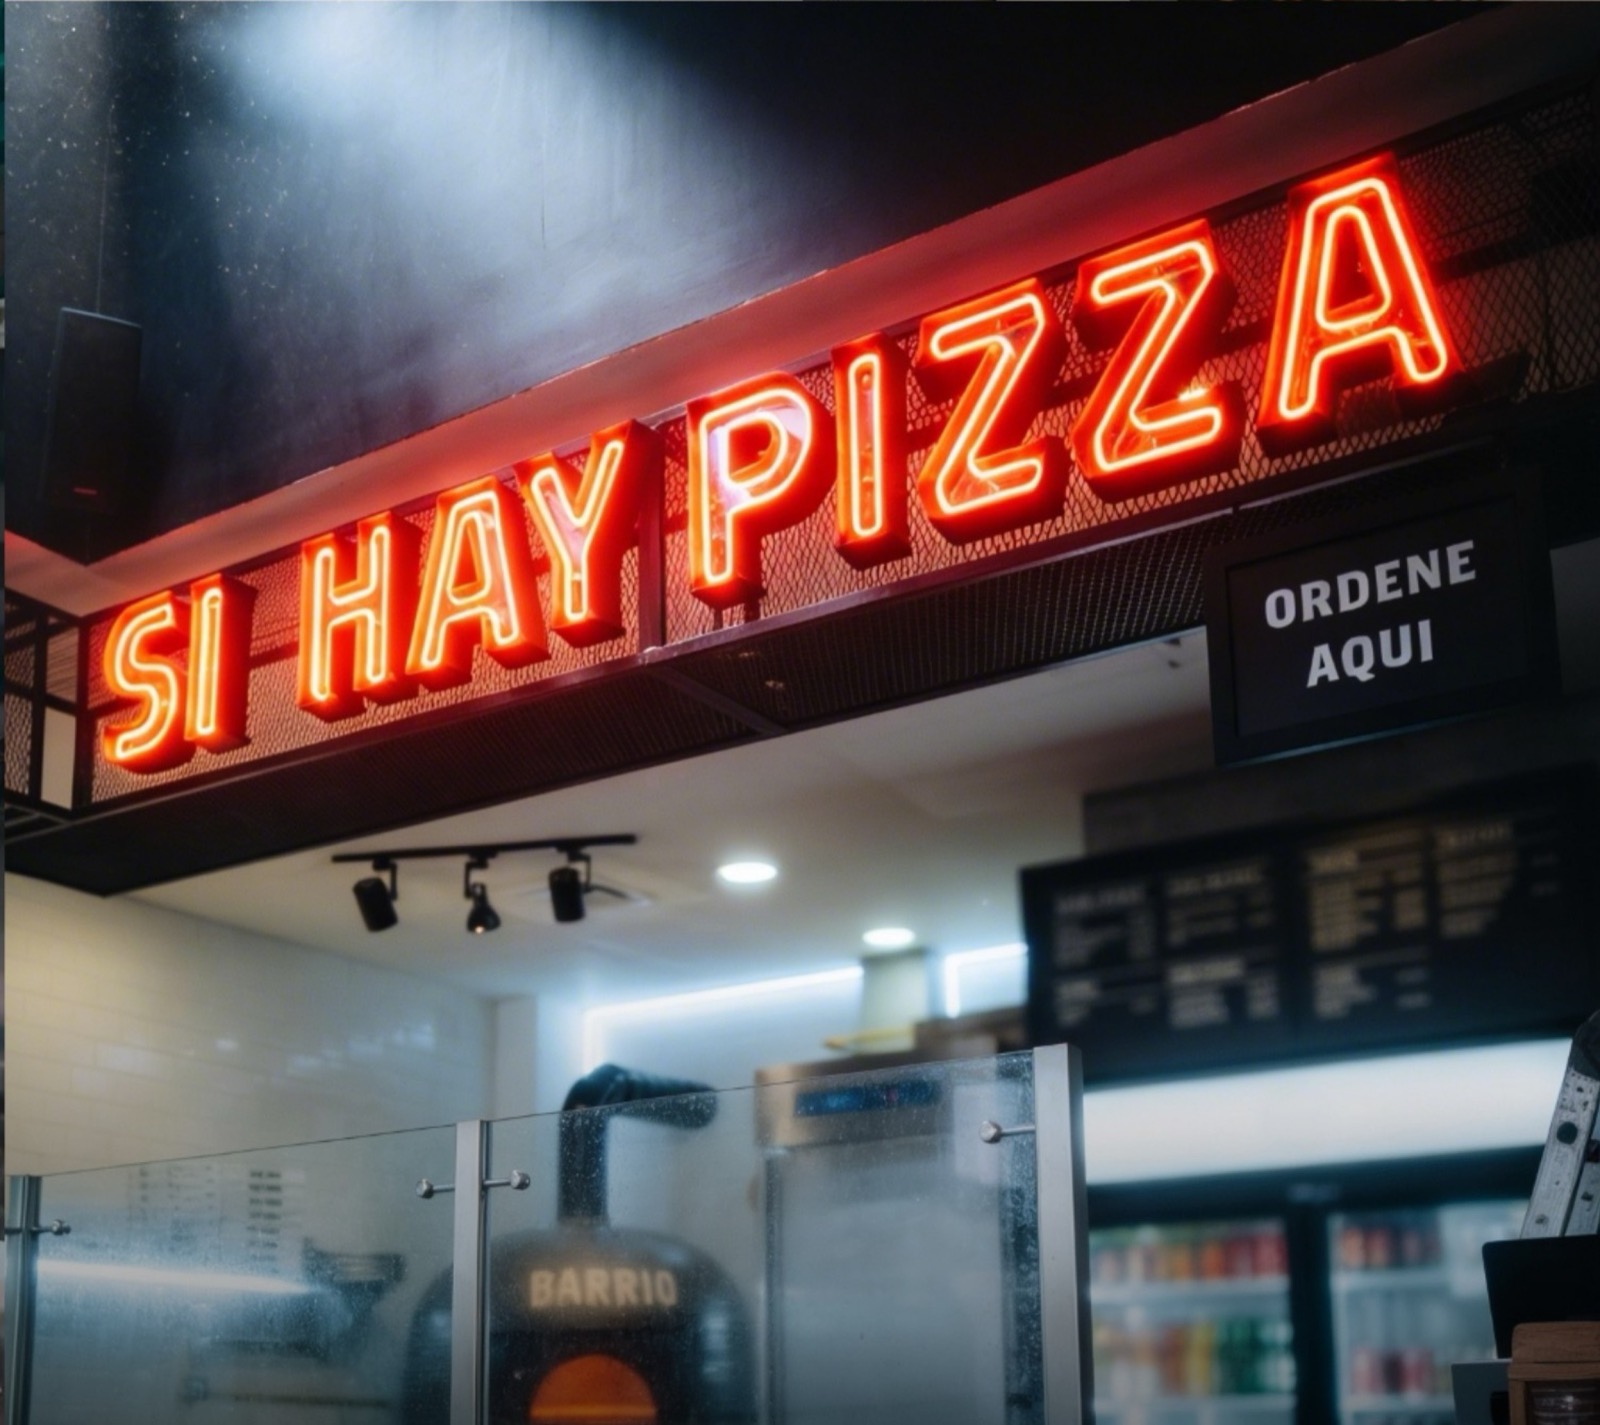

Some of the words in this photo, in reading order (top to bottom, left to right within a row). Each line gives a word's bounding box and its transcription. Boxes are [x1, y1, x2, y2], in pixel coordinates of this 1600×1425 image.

[104, 575, 236, 768] SI
[299, 420, 646, 714] HAY
[688, 153, 1460, 602] PIZZA
[1265, 540, 1477, 629] ORDENE
[1306, 619, 1434, 688] AQUI
[529, 1267, 678, 1308] BARRIO
